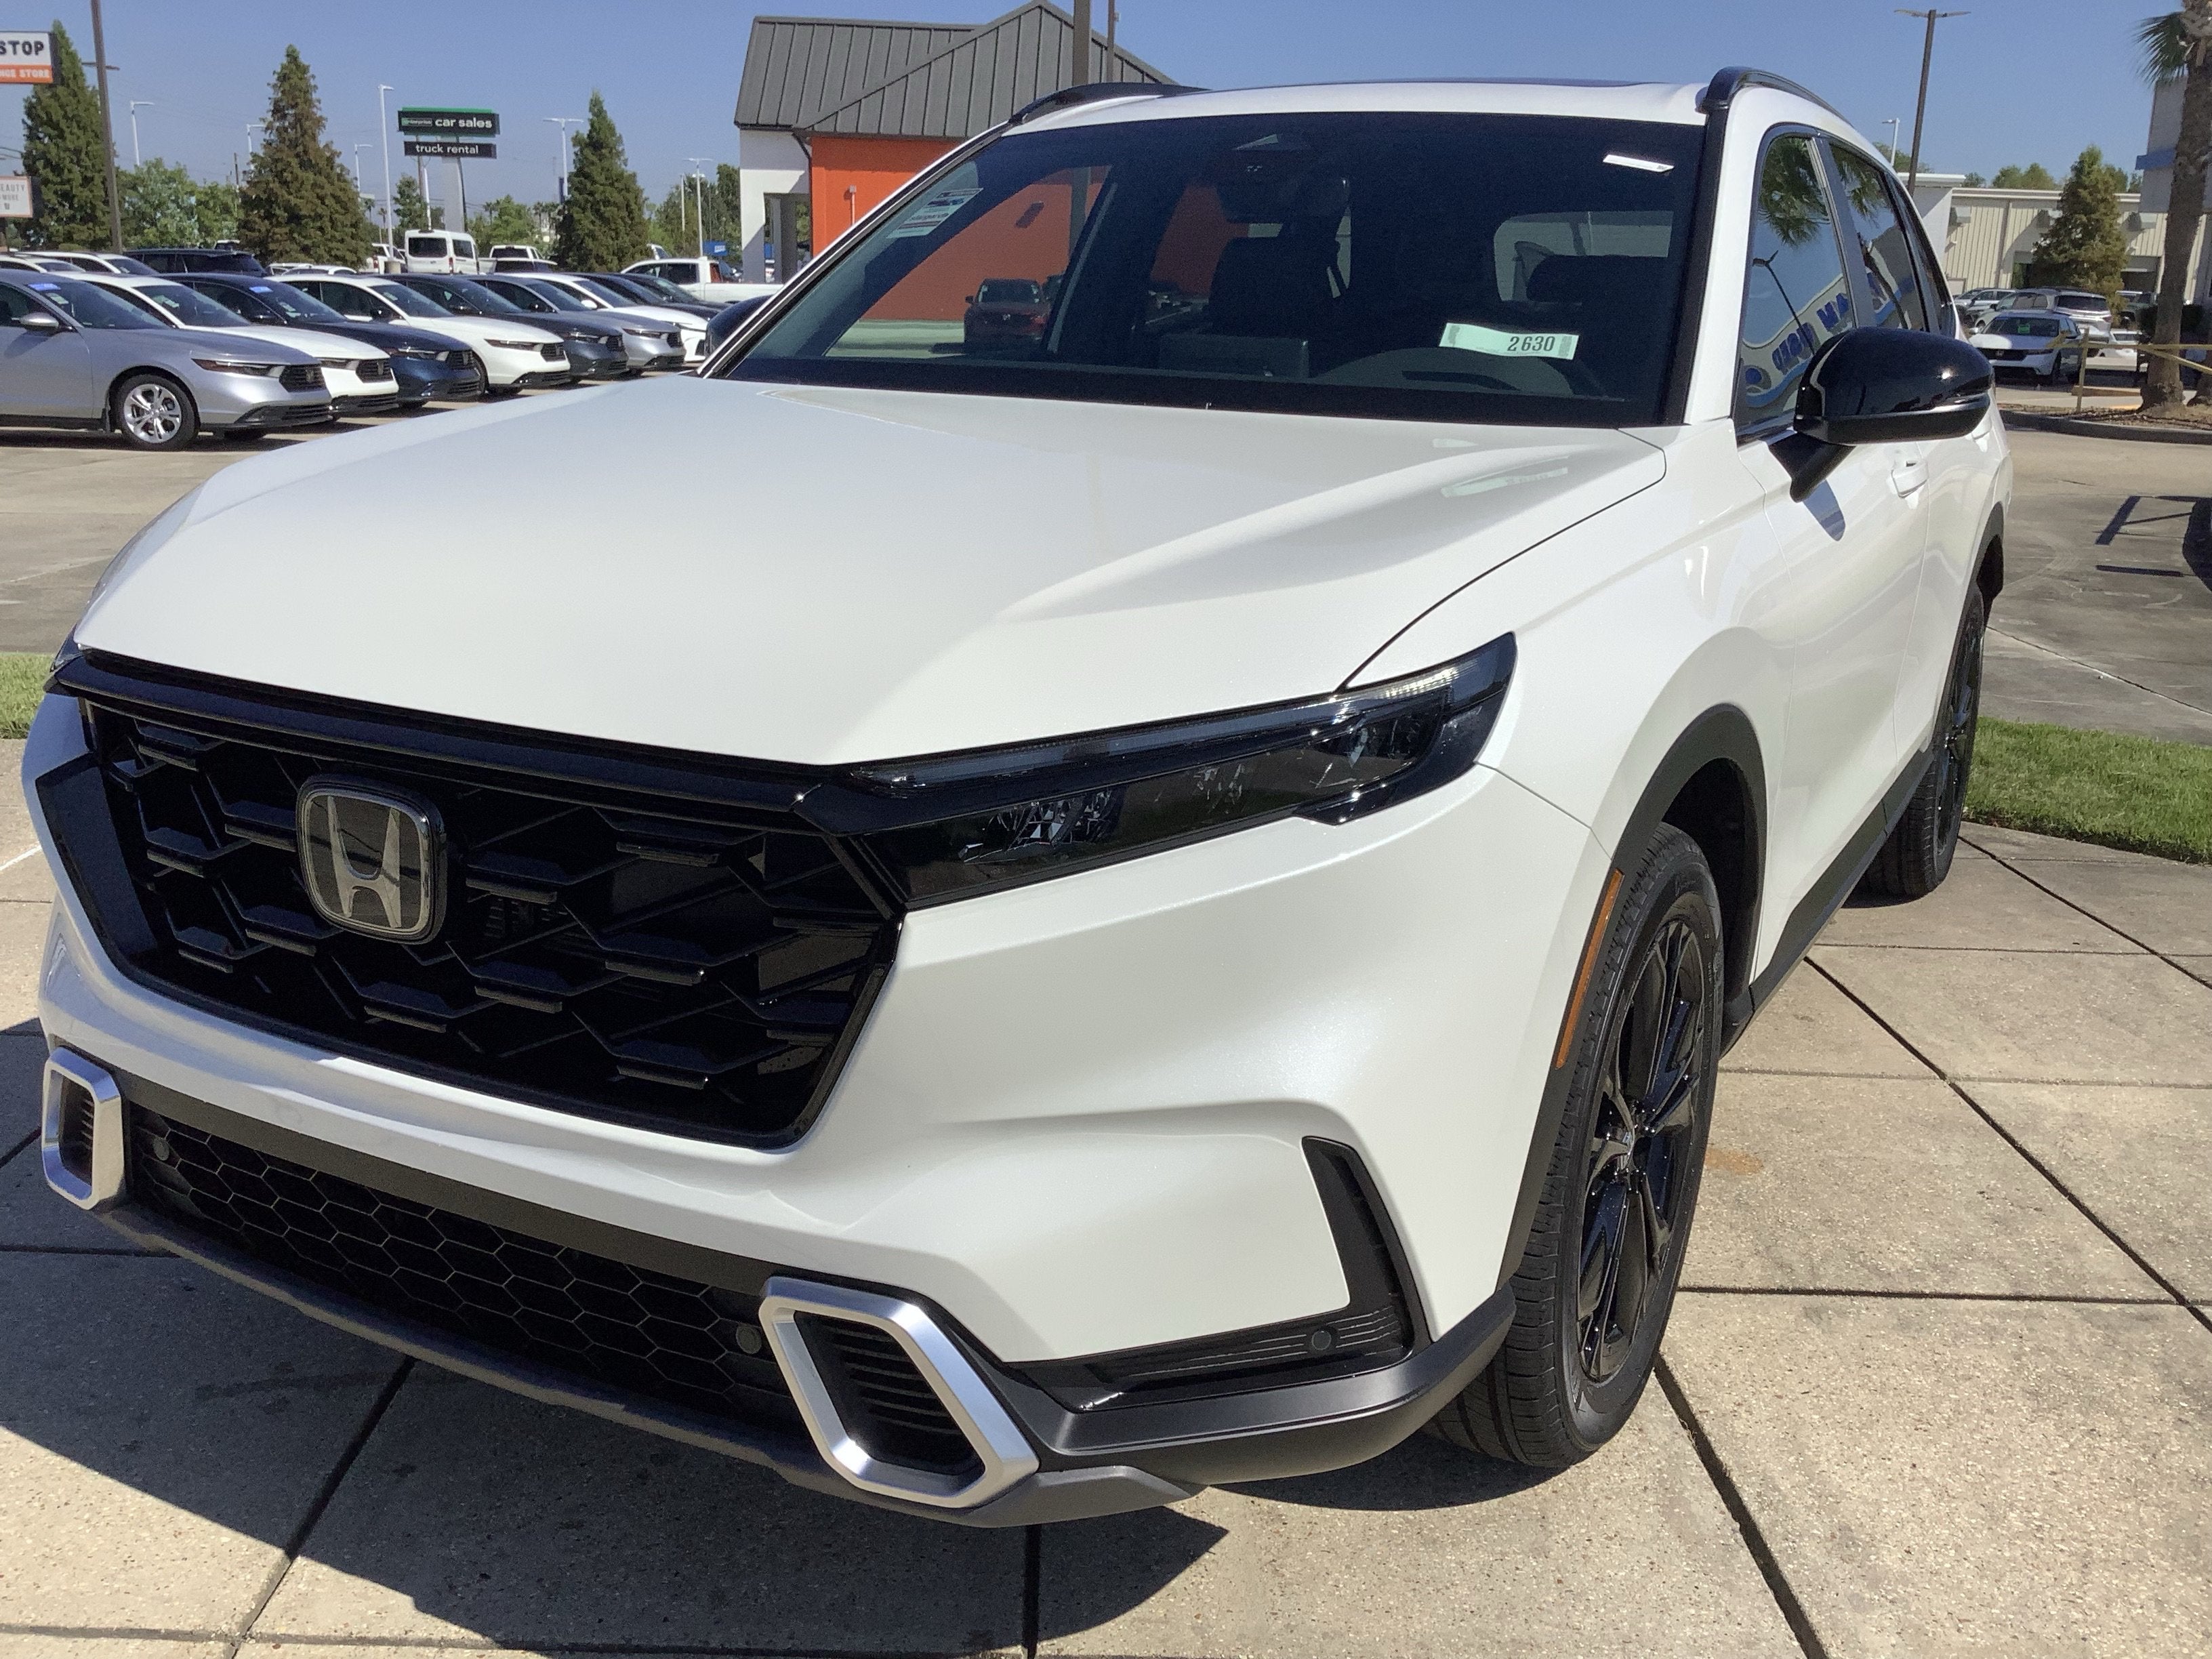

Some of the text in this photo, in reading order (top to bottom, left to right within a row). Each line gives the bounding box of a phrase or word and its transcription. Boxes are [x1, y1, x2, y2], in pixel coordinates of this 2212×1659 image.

[0, 41, 44, 56] STOP
[435, 118, 456, 127] car
[458, 117, 493, 129] sales
[415, 144, 478, 154] truck rental
[1507, 335, 1556, 352] 2630
